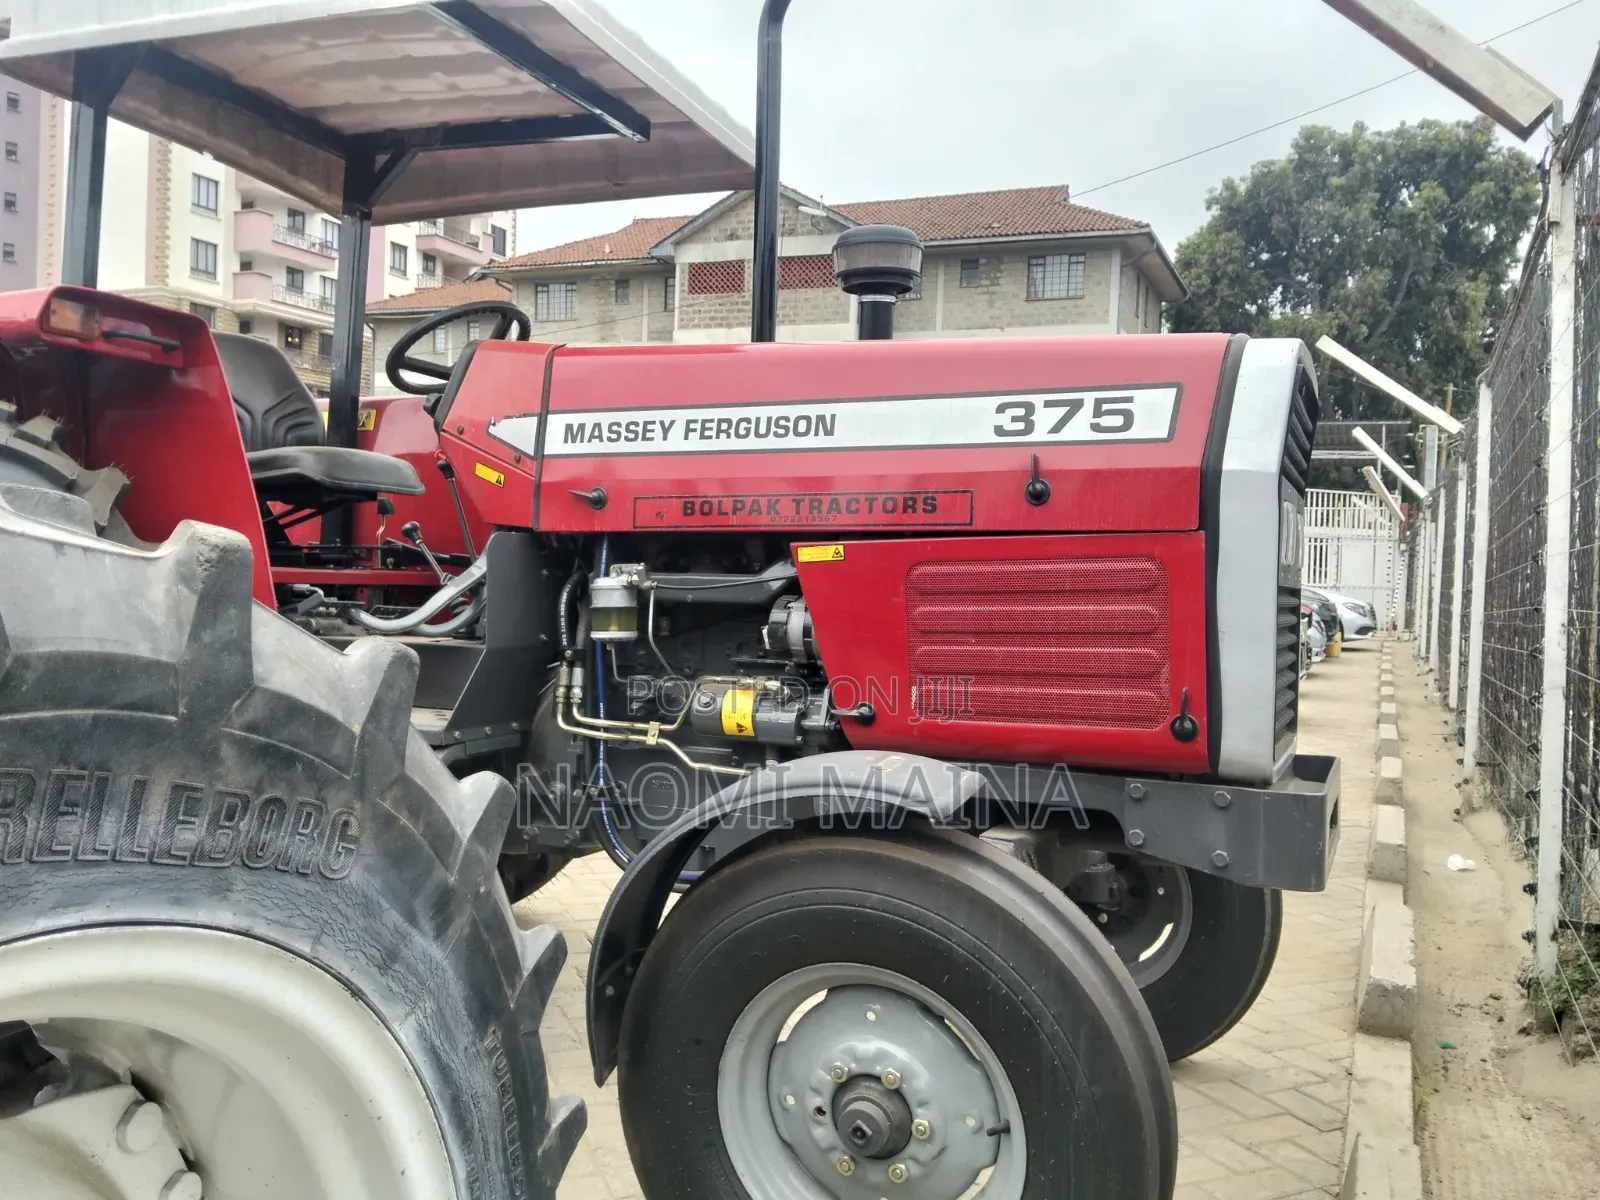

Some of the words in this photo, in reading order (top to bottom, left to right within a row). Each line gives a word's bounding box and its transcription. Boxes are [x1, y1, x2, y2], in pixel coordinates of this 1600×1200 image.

[563, 420, 677, 445] MASSEY
[683, 413, 837, 441] FERGUSON
[993, 396, 1135, 438] 375
[682, 498, 781, 518] BOLPAK
[792, 494, 939, 516] TRACTORS
[484, 1026, 526, 1200] TUBELES
